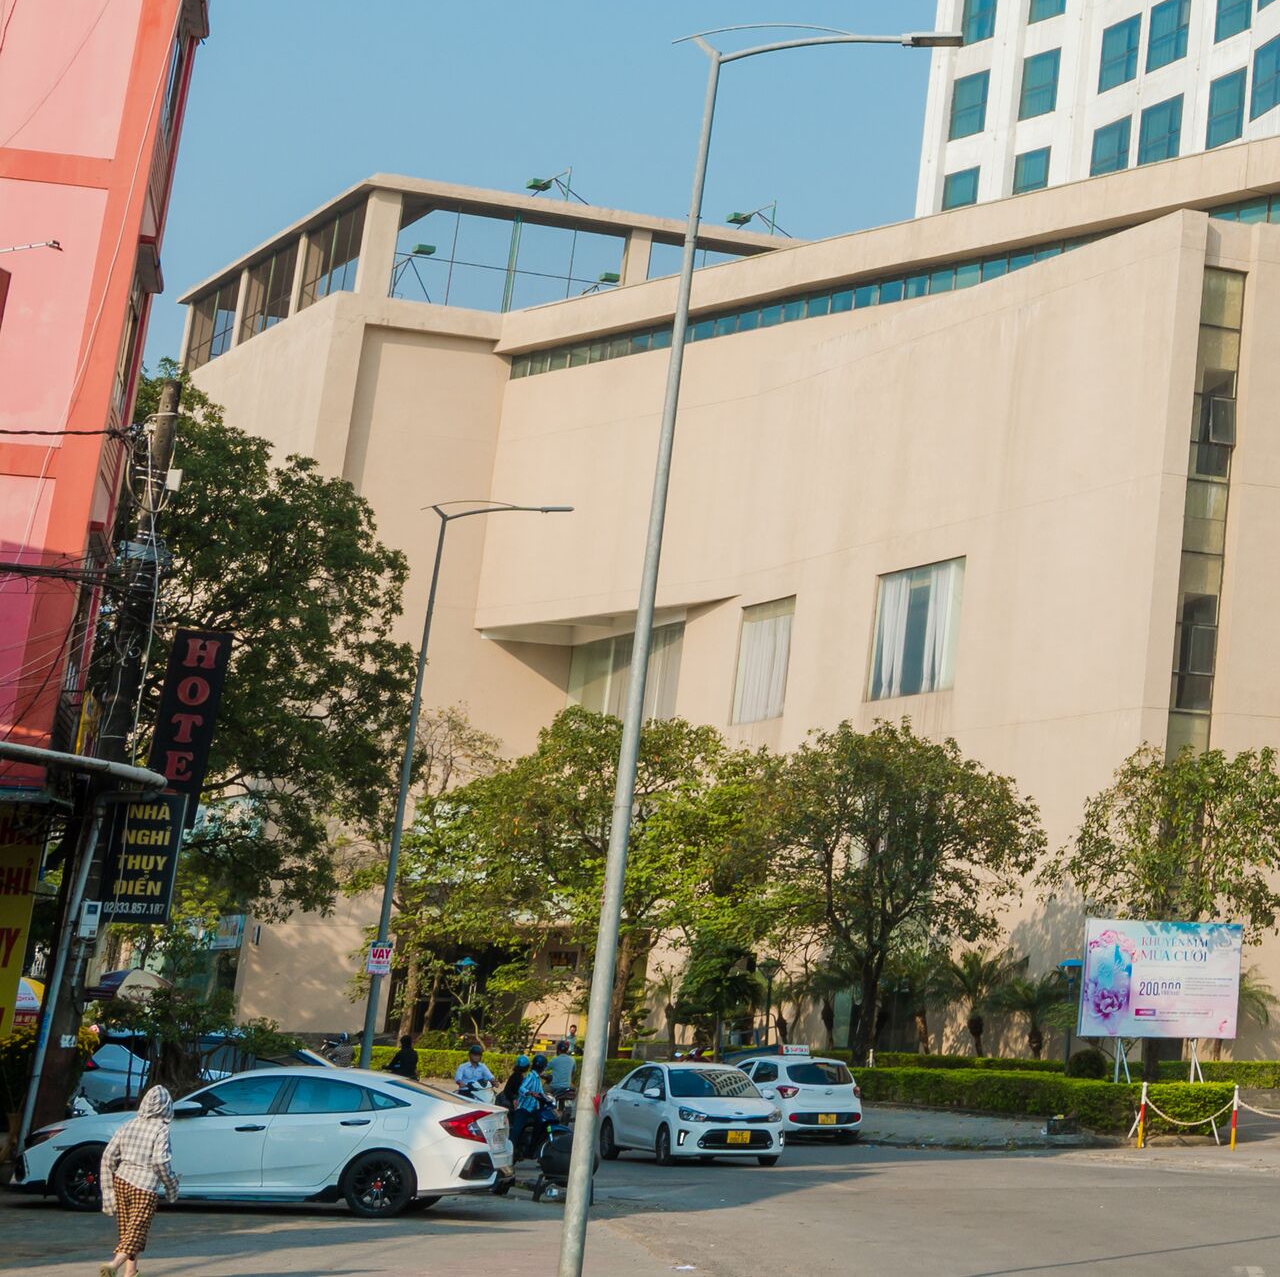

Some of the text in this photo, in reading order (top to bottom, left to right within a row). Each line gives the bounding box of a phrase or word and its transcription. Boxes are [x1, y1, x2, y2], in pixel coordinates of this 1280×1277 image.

[160, 637, 221, 795] HOTE
[130, 802, 171, 820] NHÀ
[121, 826, 172, 846] NGHỈ
[117, 854, 168, 873] THỤY
[372, 948, 391, 959] VAY
